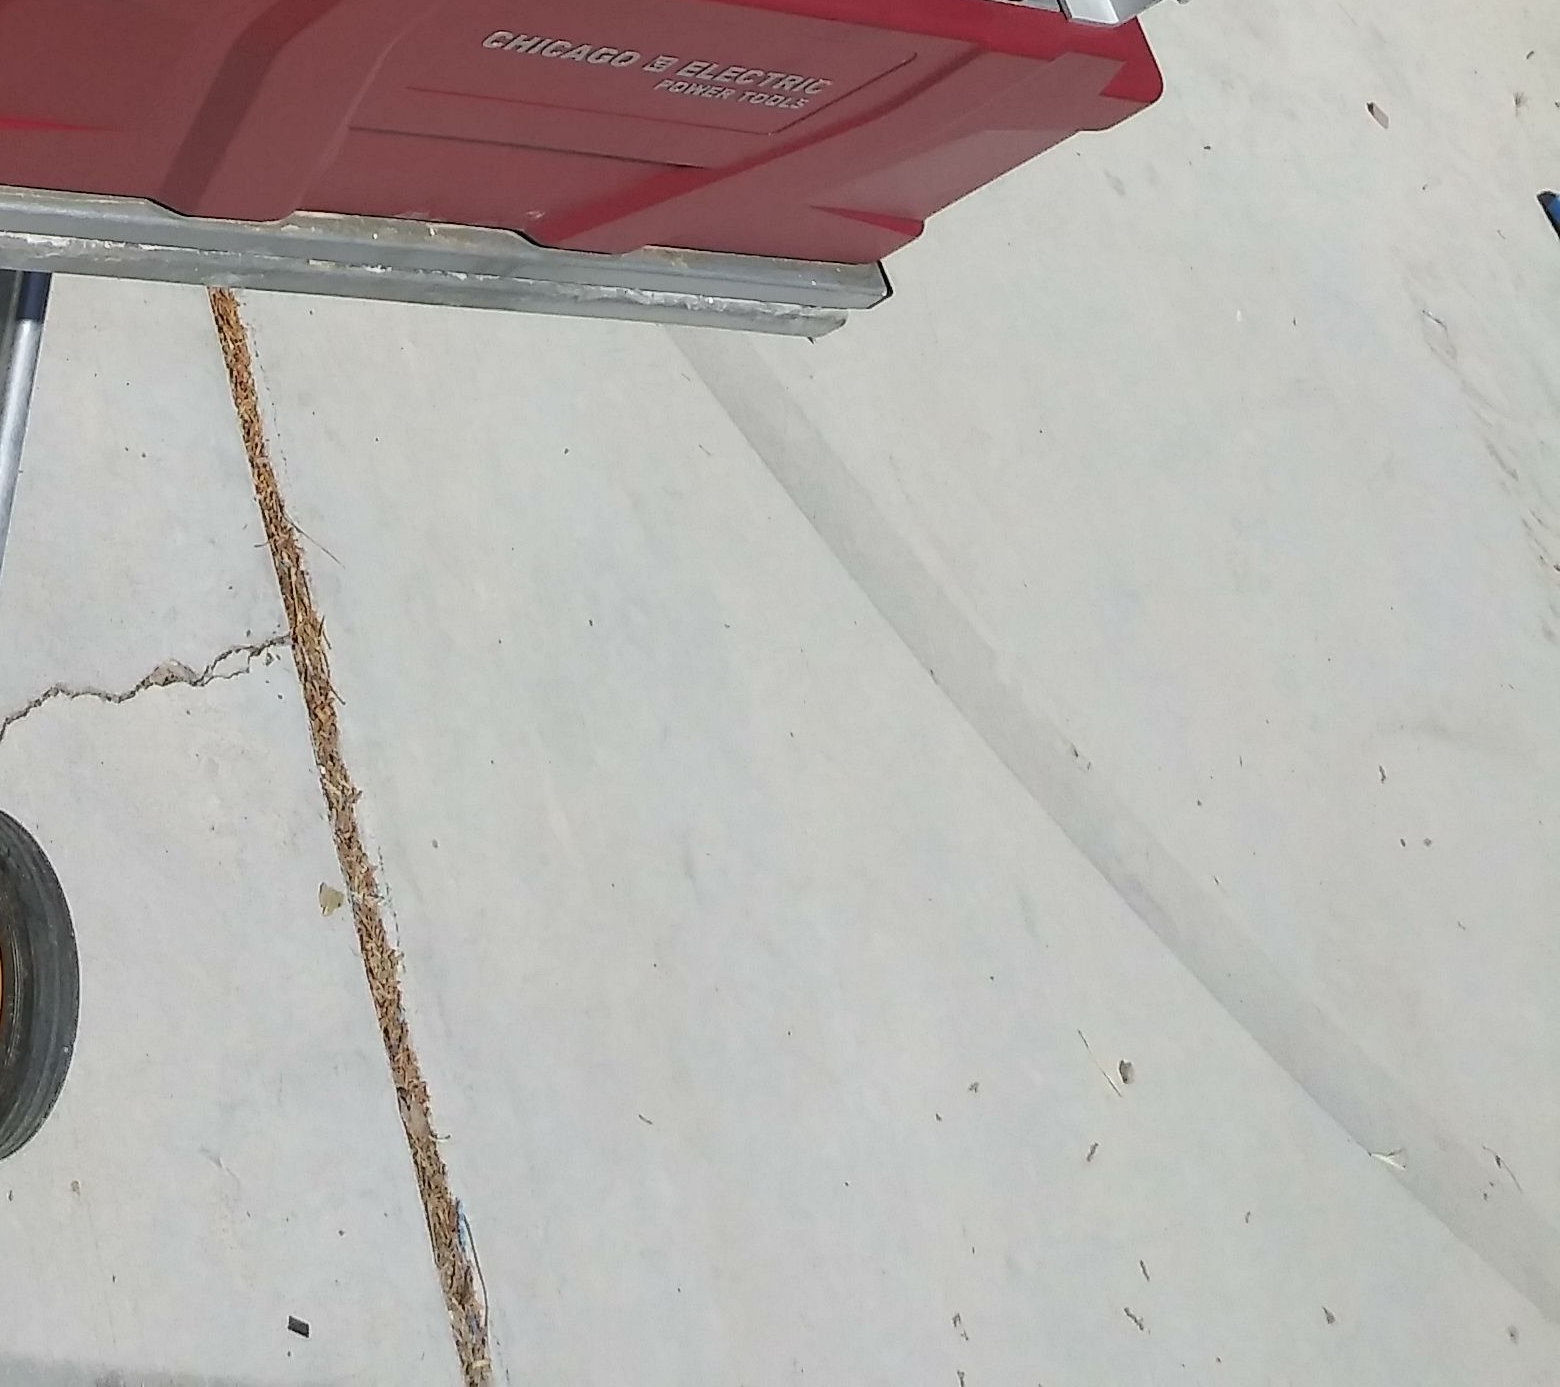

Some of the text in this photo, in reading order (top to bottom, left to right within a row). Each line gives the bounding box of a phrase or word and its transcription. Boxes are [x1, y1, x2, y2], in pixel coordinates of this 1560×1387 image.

[481, 30, 641, 68] CHICAGO
[676, 59, 833, 95] ELECTRIC
[653, 78, 810, 111] POWER TOOLS
